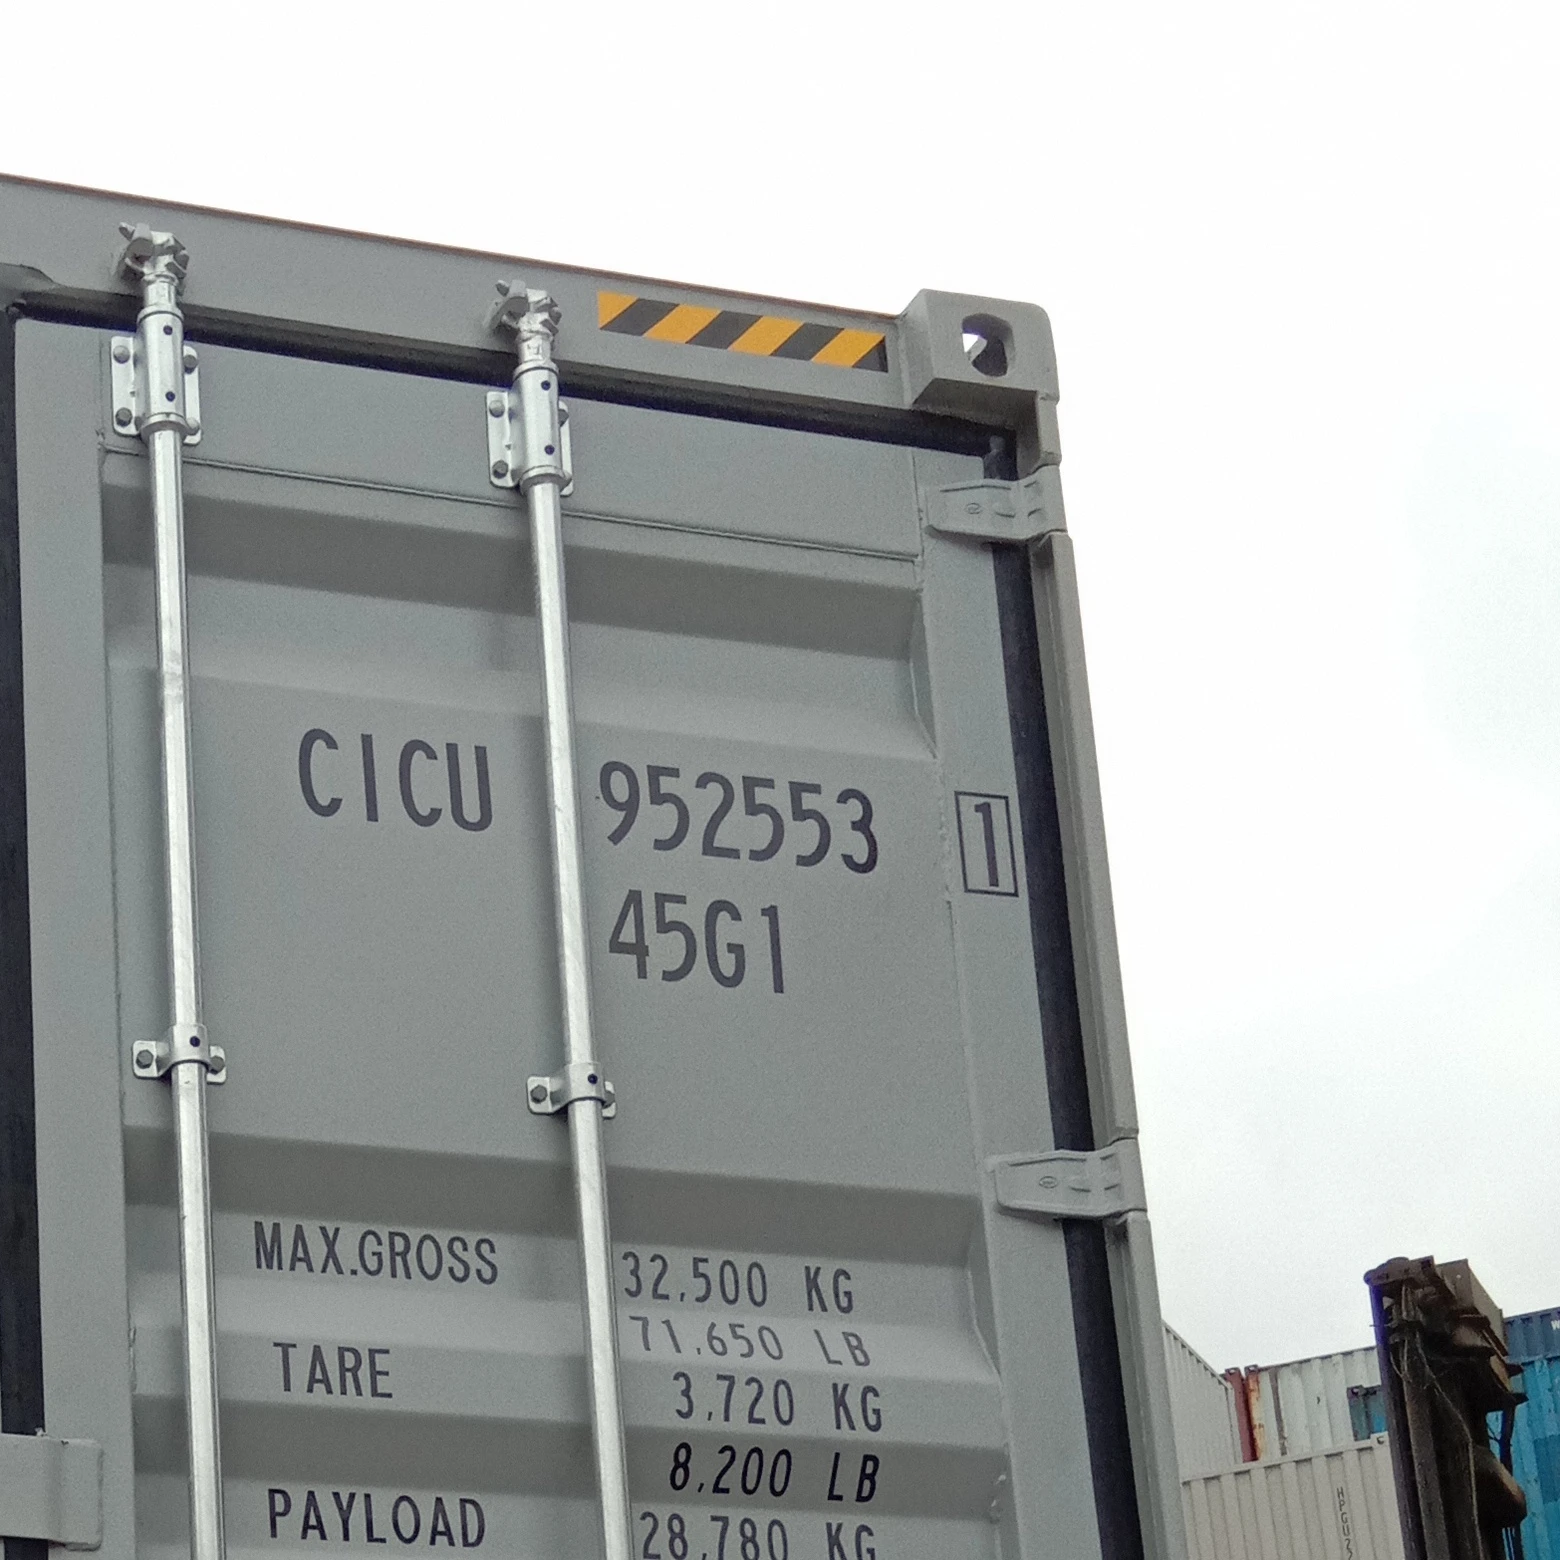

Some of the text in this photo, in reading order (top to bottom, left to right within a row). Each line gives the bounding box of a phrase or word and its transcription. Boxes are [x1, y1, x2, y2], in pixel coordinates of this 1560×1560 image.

[298, 728, 1000, 889] CICU 952553 1
[609, 889, 785, 994] 45G1
[255, 1221, 854, 1314] MAX.GROSS 32,500 KG
[629, 1316, 871, 1367] 71,650 LB
[273, 1342, 883, 1433] TARE 3,720 KG
[670, 1442, 880, 1504] 8,200 LB
[268, 1489, 486, 1549] PAYLOAD
